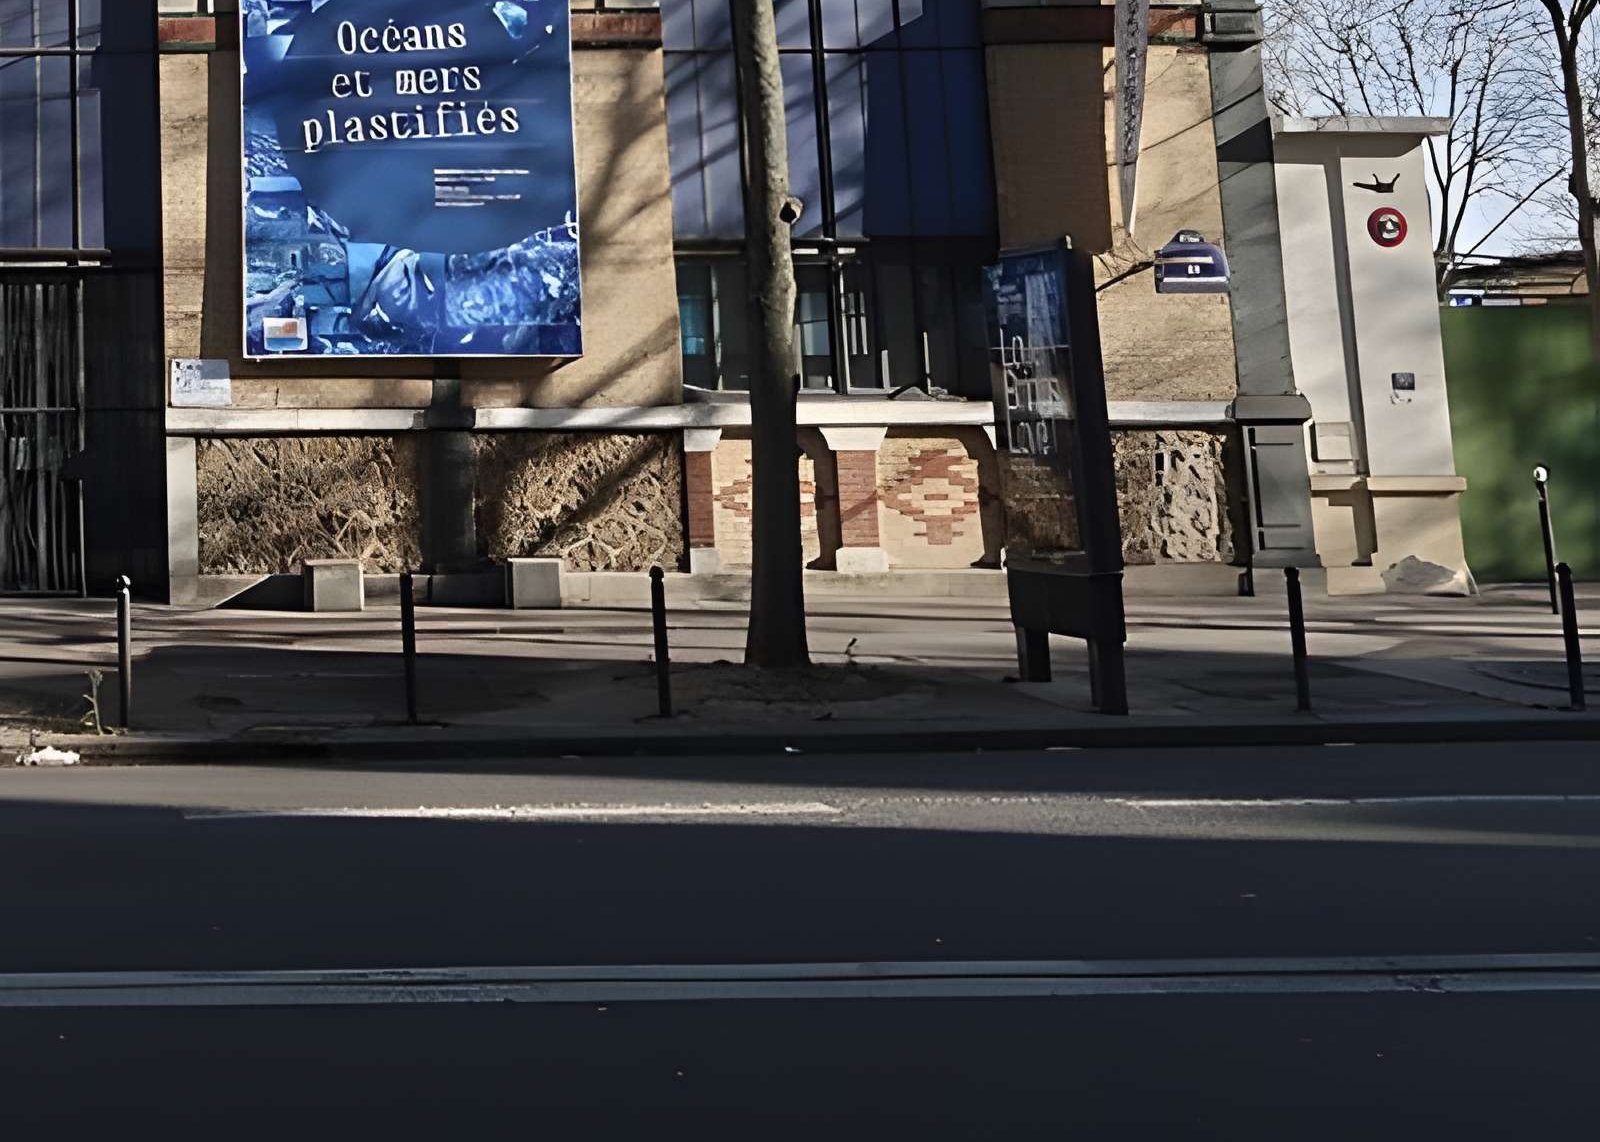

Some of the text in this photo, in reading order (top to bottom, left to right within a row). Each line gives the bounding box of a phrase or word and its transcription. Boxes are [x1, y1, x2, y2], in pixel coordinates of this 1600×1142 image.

[337, 18, 467, 55] Océans
[332, 65, 481, 98] et mers
[302, 101, 520, 154] plastifiés
